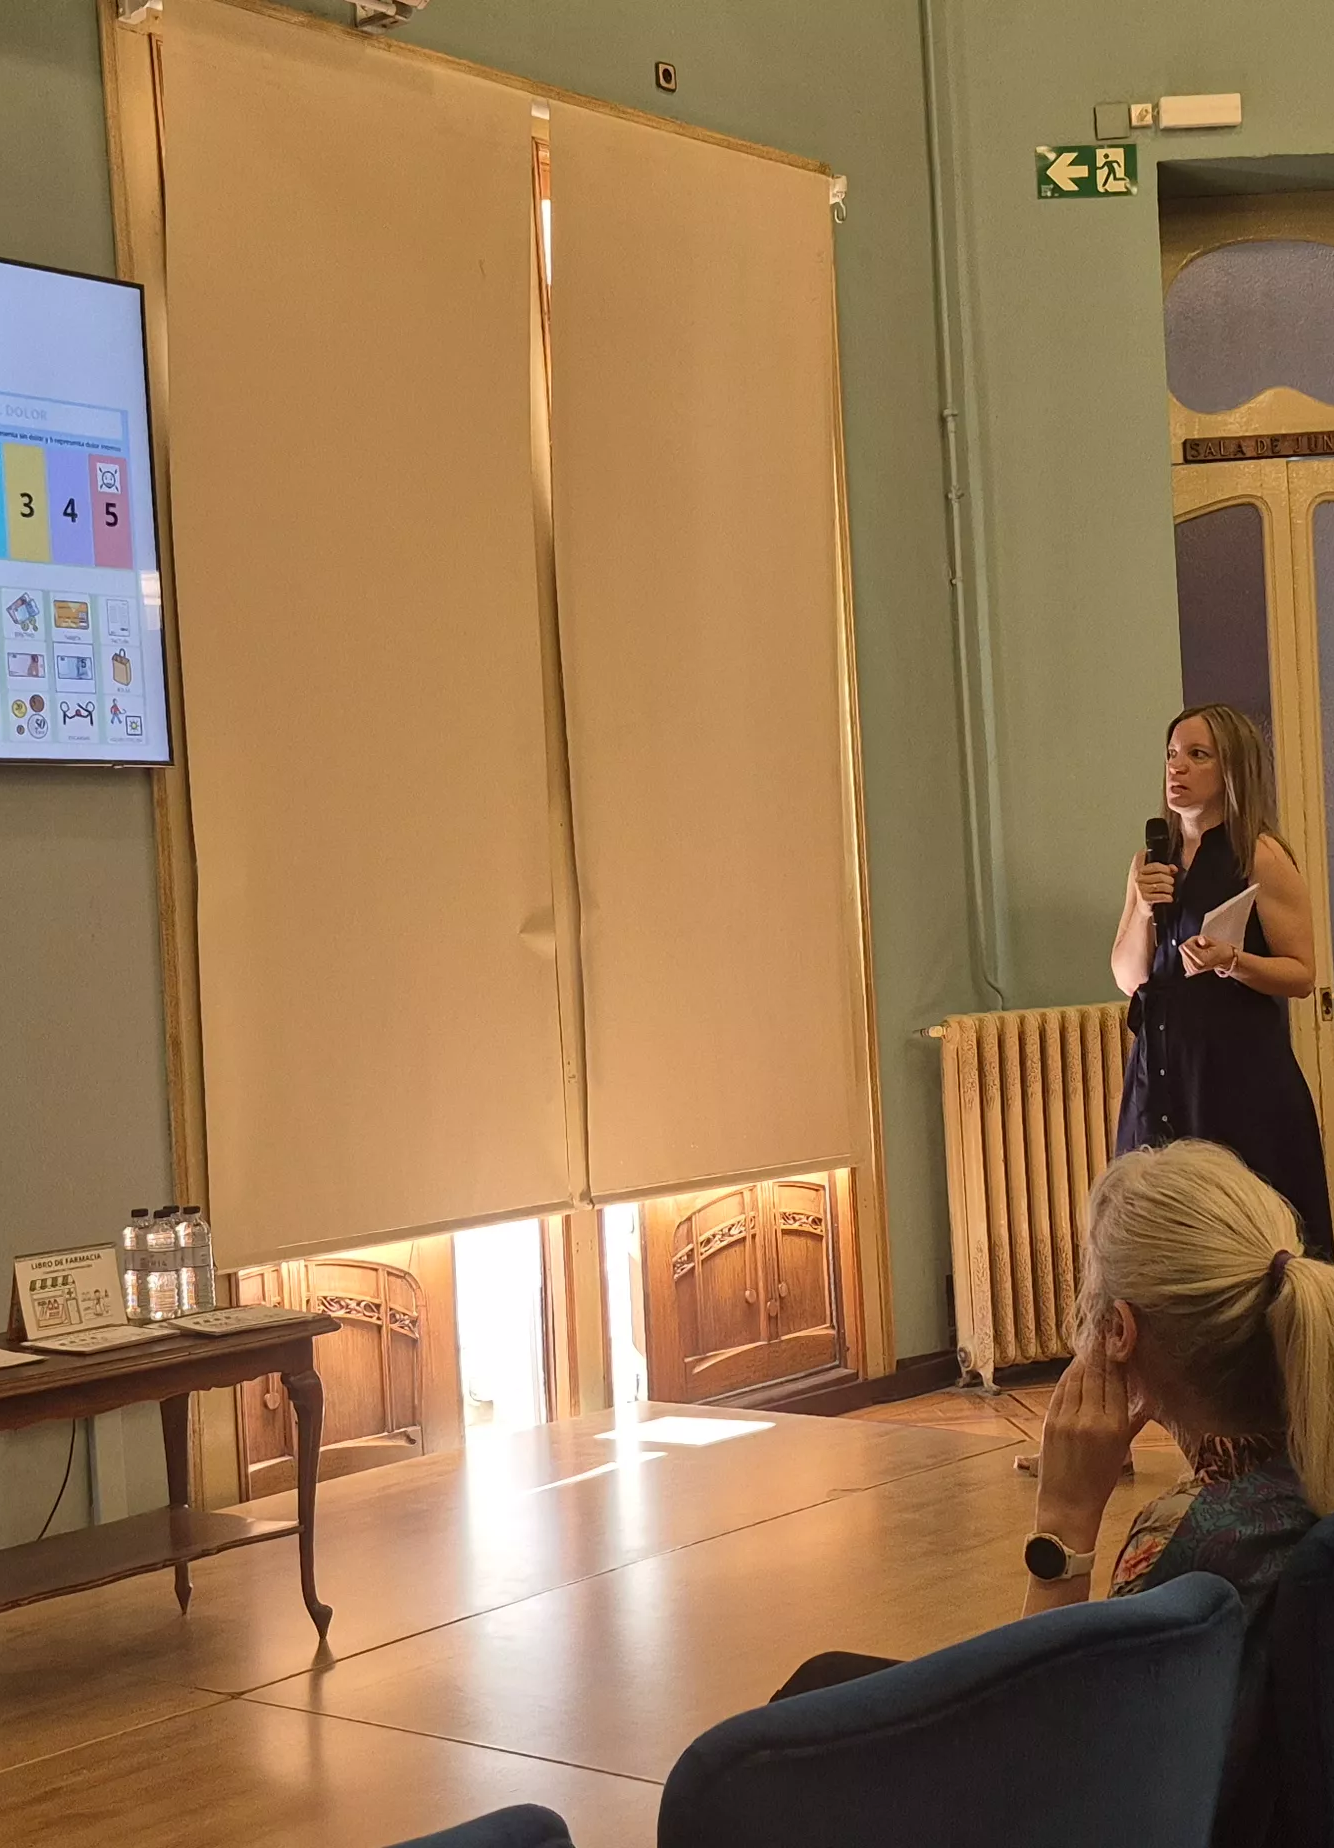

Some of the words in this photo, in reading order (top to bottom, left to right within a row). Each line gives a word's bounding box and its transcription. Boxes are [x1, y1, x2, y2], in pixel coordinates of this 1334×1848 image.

[5, 401, 48, 421] DOLOR
[1189, 441, 1245, 459] SALA
[1255, 437, 1282, 455] DE
[19, 492, 35, 518] 3
[62, 498, 78, 523] 4
[105, 502, 119, 527] 5
[30, 1260, 53, 1270] LIBRO
[54, 1258, 64, 1267] DE
[65, 1252, 102, 1265] FARMACIA
